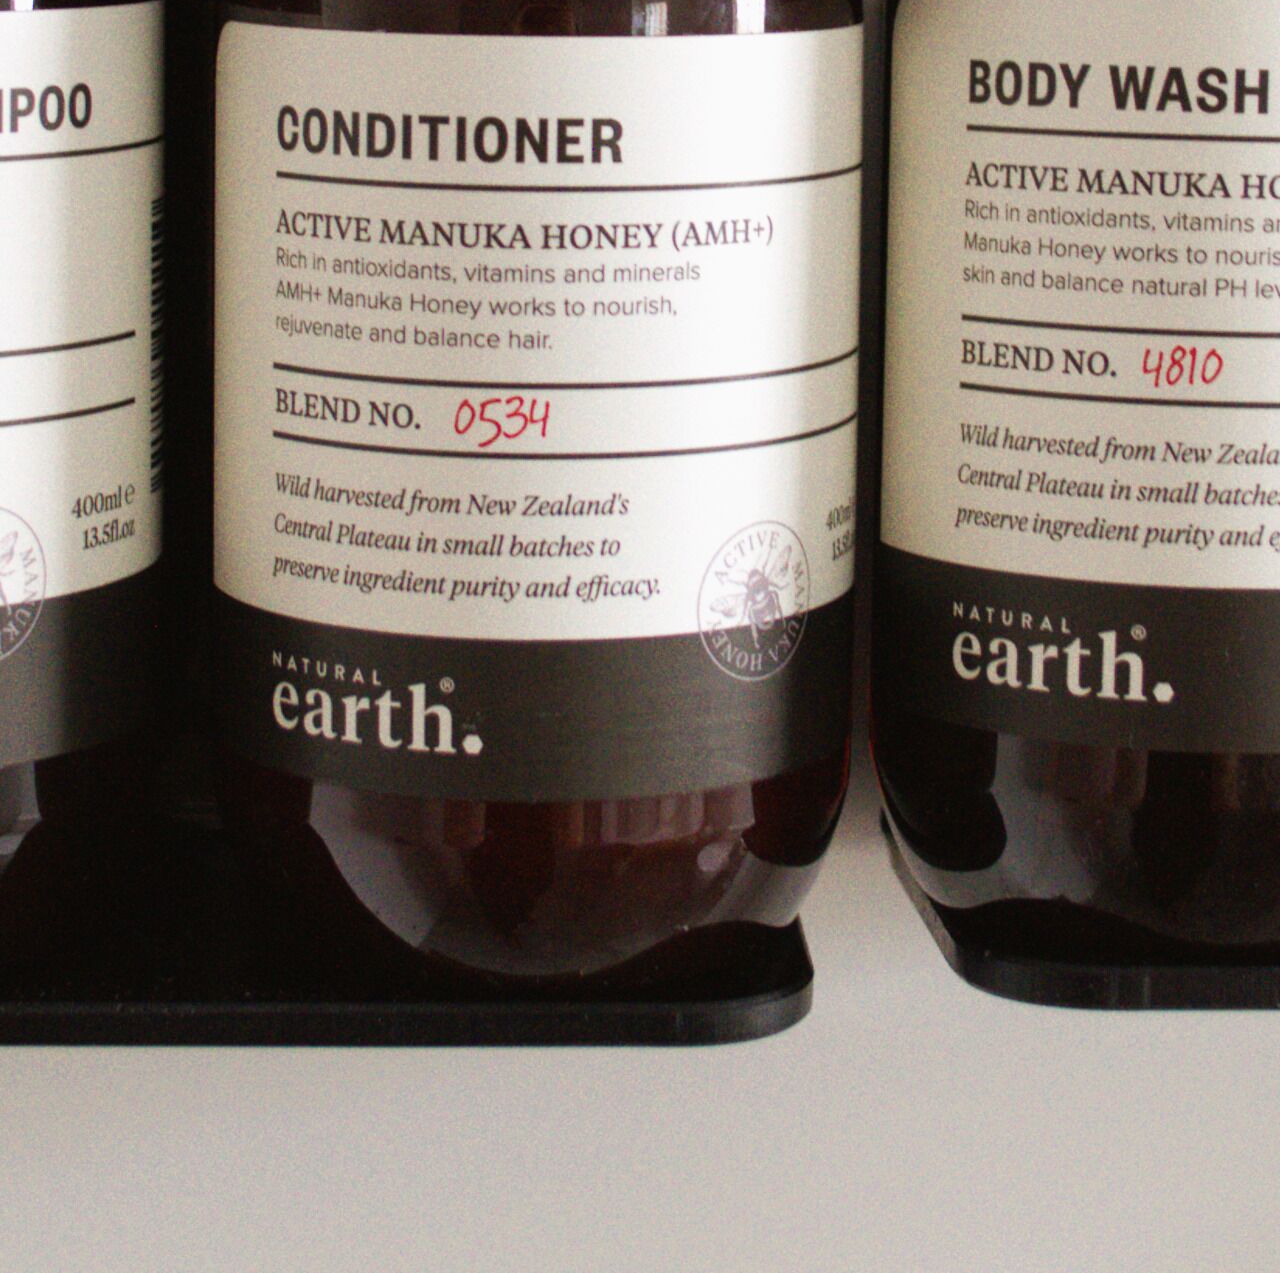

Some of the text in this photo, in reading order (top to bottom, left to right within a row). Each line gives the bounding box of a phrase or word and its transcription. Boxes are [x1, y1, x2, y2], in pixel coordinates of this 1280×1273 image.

[968, 59, 1270, 115] BODY WASH
[277, 105, 624, 165] CONDITIONER
[966, 162, 1068, 193] ACTIVE
[1076, 170, 1231, 199] MANUKA
[275, 209, 773, 249] ACTIVE MANUKA HONEY (AMH+)
[965, 199, 999, 221] Rich
[1005, 202, 1020, 223] in
[1027, 203, 1155, 232] antioxidants,
[1164, 211, 1254, 233] vitamins
[276, 246, 700, 285] Rich in antioxidants, vitamins and minerals
[964, 232, 1032, 256] Manuka
[1038, 238, 1106, 265] Honey
[1112, 241, 1178, 263] works
[1186, 244, 1207, 265] to
[275, 280, 677, 320] AMH+ Manuka Honey works to nourish,
[963, 263, 995, 285] skin
[1001, 268, 1035, 289] and
[1042, 269, 1124, 294] balance
[1131, 275, 1206, 297] natural
[1215, 279, 1248, 298] PH
[275, 313, 553, 350] rejuvenate and balance hair.
[961, 340, 1223, 387] BLEND NO. 4810
[275, 388, 550, 447] BLEND NO. 0534
[960, 424, 998, 448] Wild
[1002, 428, 1099, 458] harvested
[1098, 436, 1155, 463] from
[1160, 442, 1211, 464] New
[72, 484, 121, 518] 400ml
[275, 472, 629, 517] Wild harvested from New Zealand's
[958, 464, 1020, 492] Central
[1026, 473, 1104, 500] Plateau
[1111, 480, 1131, 501] in
[1136, 482, 1198, 504] small
[274, 513, 621, 557] Central Plateau in small batches to
[956, 506, 1028, 534] preserve
[1032, 513, 1139, 542] ingredient
[1143, 520, 1213, 548] purity
[1219, 525, 1262, 548] and
[715, 530, 779, 585] ACTIVE
[273, 556, 661, 603] preserve ingredient purity and efficacy.
[953, 601, 1071, 633] NATURAL
[273, 650, 382, 686] NATURAL
